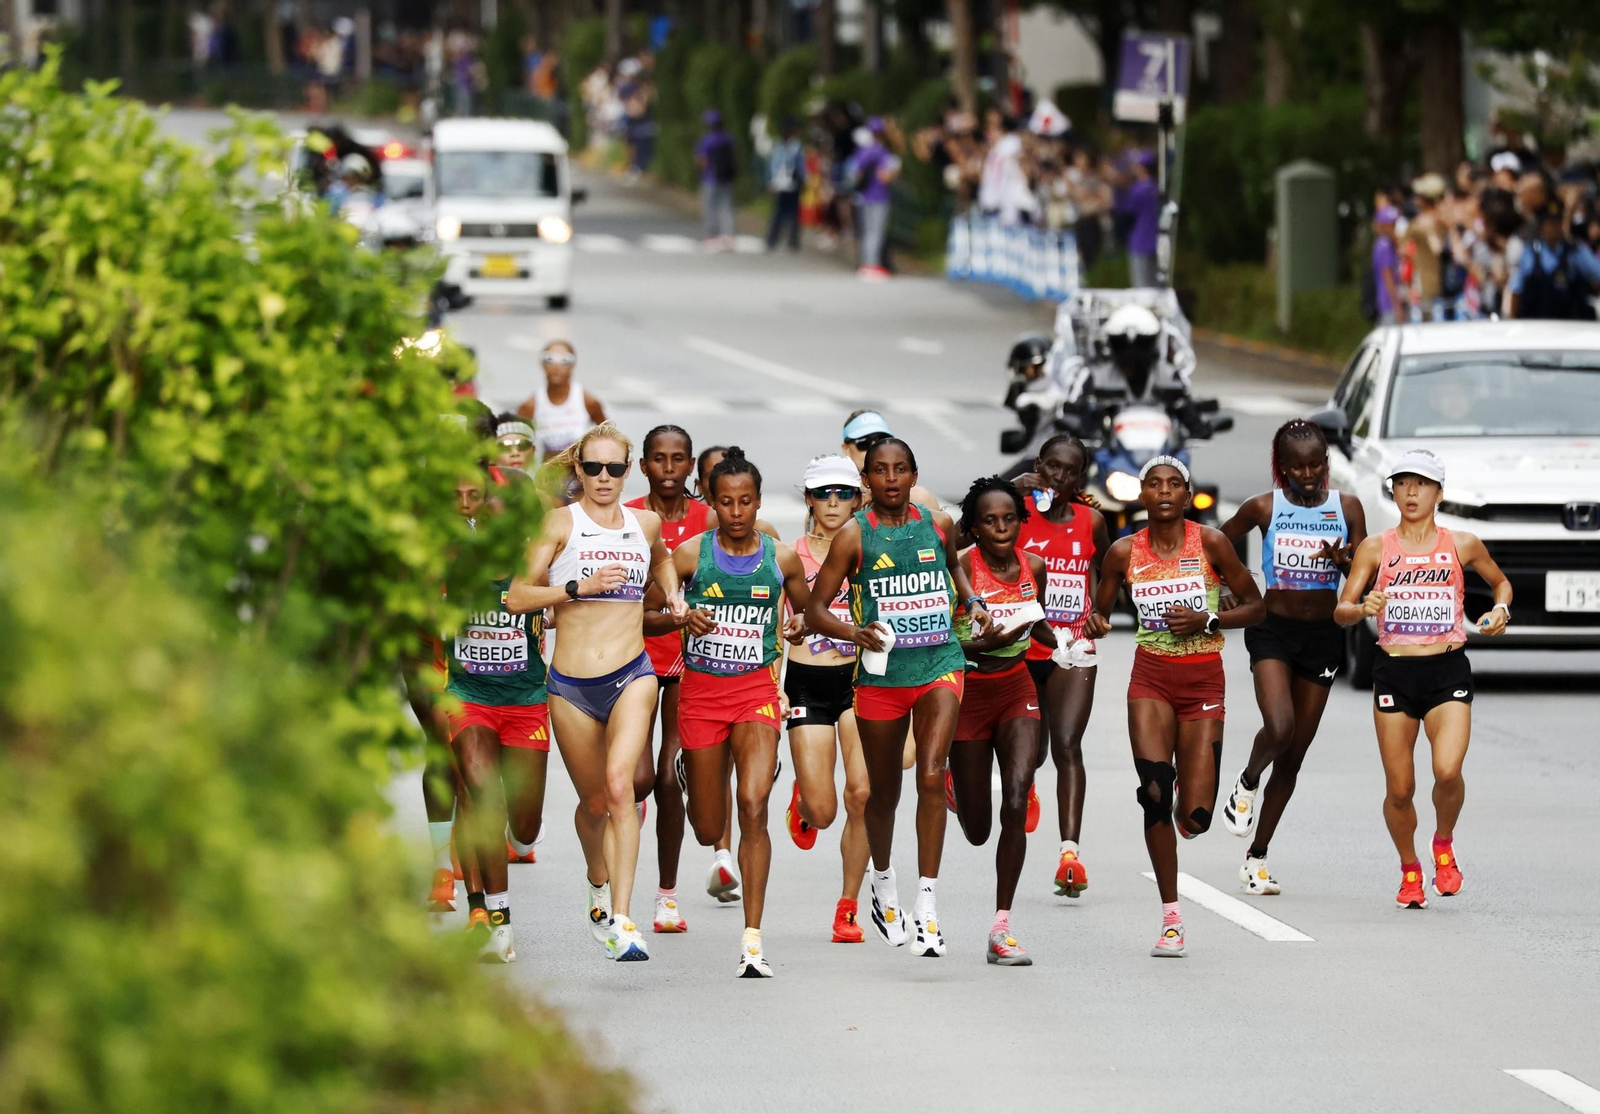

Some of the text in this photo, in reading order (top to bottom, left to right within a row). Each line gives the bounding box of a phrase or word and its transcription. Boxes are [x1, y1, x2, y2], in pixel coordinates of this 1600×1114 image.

[1275, 522, 1342, 533] SOUTH SUDAN
[1277, 537, 1323, 550] HON
[579, 550, 646, 563] HONDA
[1044, 556, 1090, 573] HRAIN
[1278, 552, 1337, 571] LOLIHA
[869, 570, 947, 598] ETHIOPIA
[1048, 577, 1084, 589] NDA
[1389, 568, 1451, 587] JAPAN
[1134, 581, 1202, 598] HONDA
[1387, 591, 1452, 601] HONDA
[880, 596, 948, 612] HONDA
[1045, 593, 1081, 610] UMBA
[468, 610, 526, 631] HIOPIA
[1388, 605, 1451, 621] KOBAYASHI
[709, 625, 761, 639] ONDA
[886, 613, 947, 634] ASSEFA
[459, 643, 523, 661] KEBEDE
[691, 637, 759, 661] KETEMA
